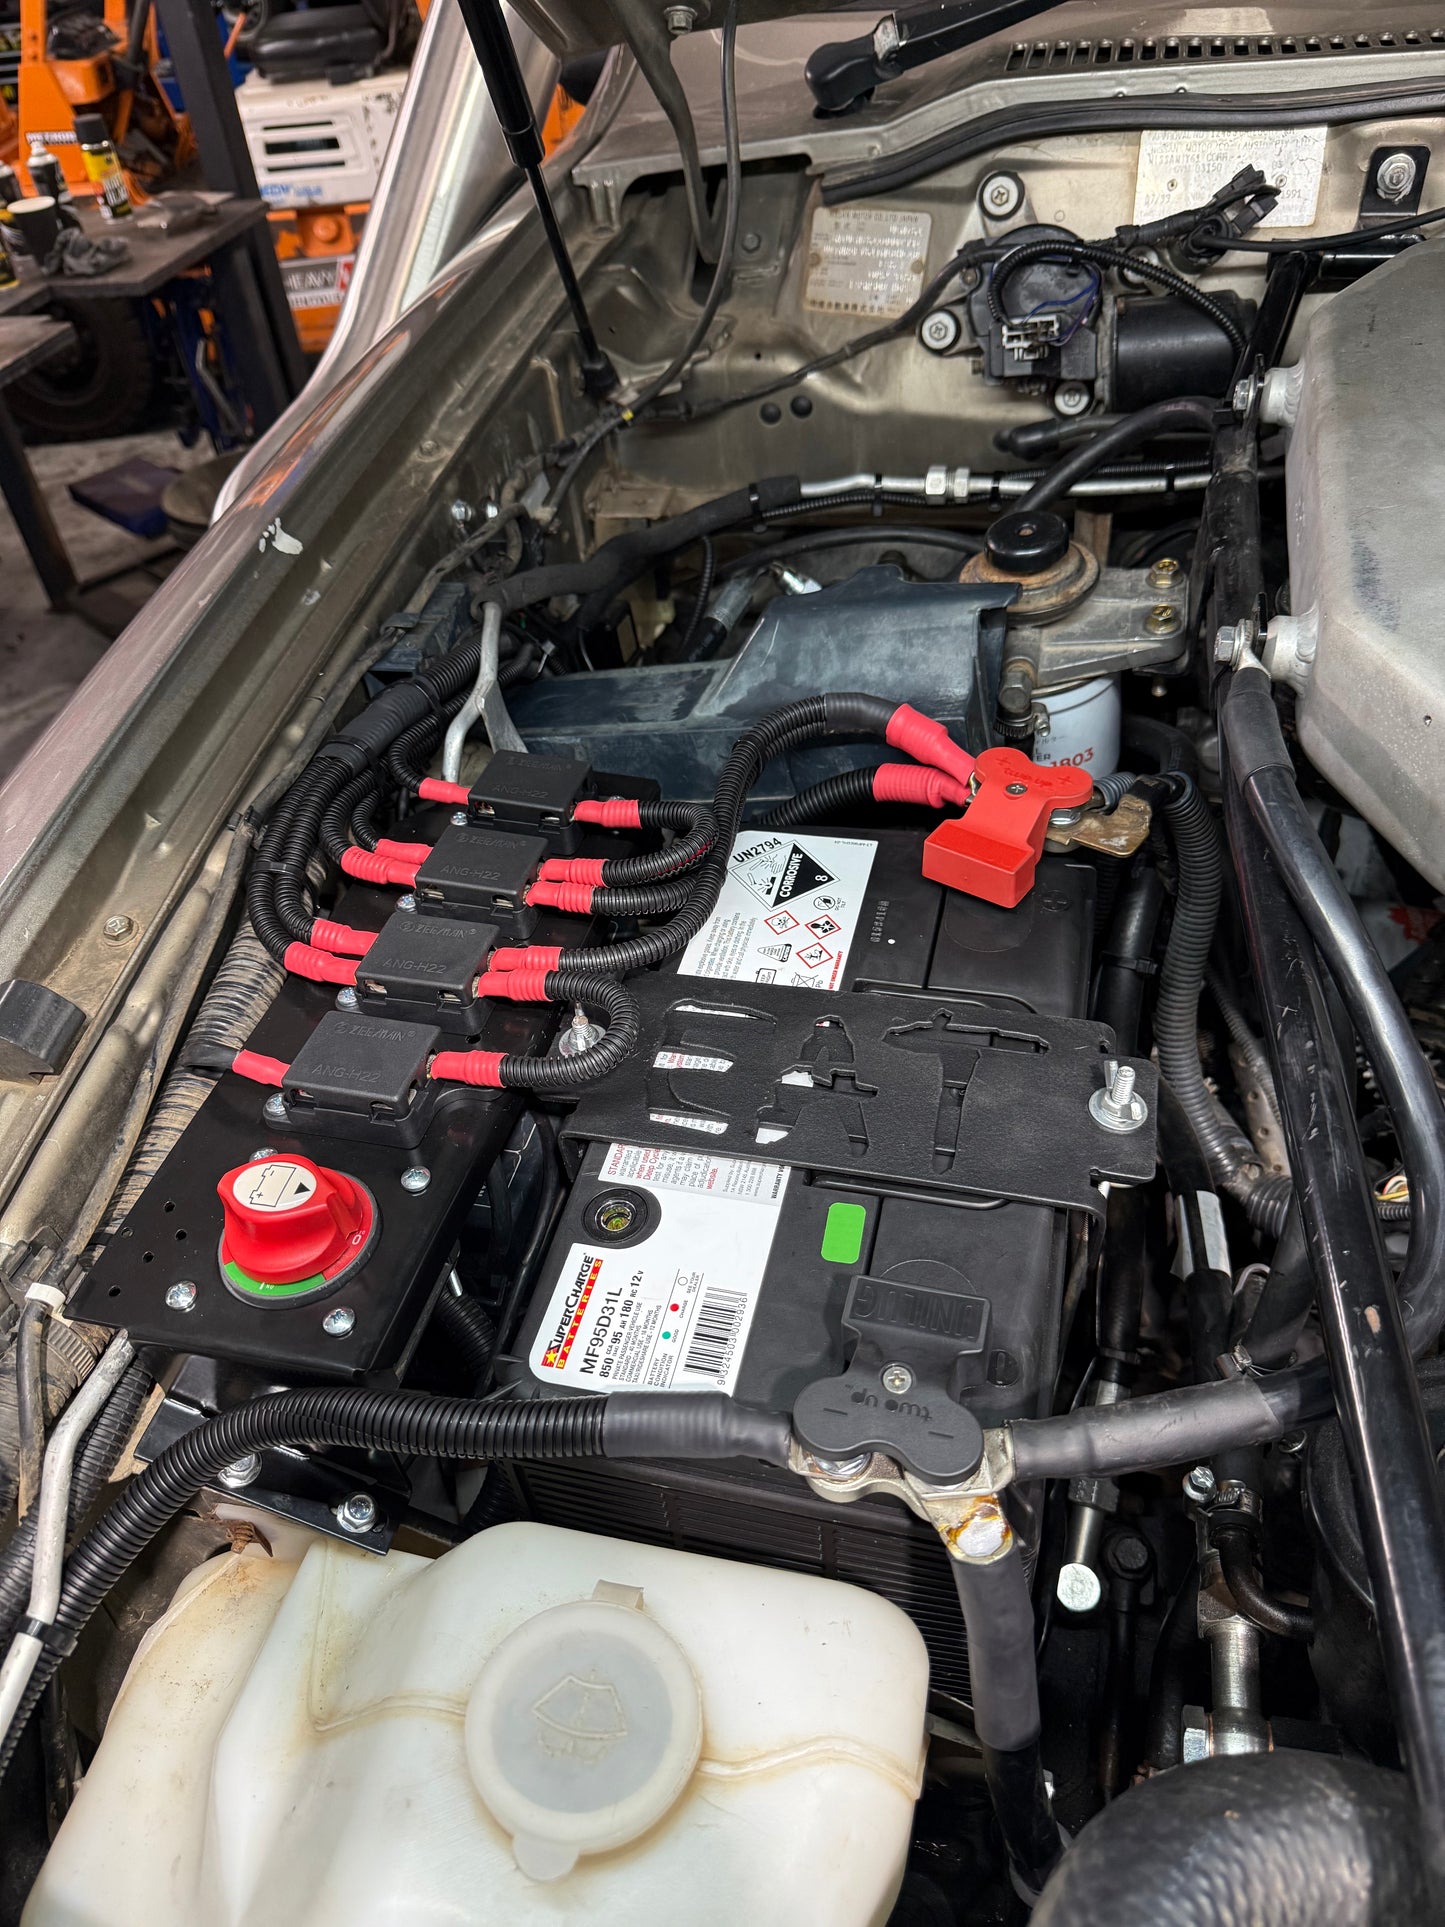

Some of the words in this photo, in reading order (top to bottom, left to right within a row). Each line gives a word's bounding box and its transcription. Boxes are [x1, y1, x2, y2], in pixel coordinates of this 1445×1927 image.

[732, 838, 783, 864] UN2794
[440, 866, 502, 881] ANG-H22
[779, 852, 804, 898] CORROSIVE
[815, 873, 829, 882] 8
[382, 959, 449, 975] ANG-H22
[833, 950, 843, 969] WARRANTY
[311, 1063, 383, 1084] ANG-H22
[606, 1144, 626, 1175] STANDAR
[639, 1149, 651, 1163] used
[634, 1164, 645, 1178] when
[642, 1164, 656, 1180] Deep
[670, 1165, 683, 1184] agents
[704, 1166, 718, 1189] website.
[770, 1173, 782, 1199] WARRANTY
[629, 1275, 642, 1287] 12
[691, 1274, 700, 1292] DEALER
[629, 1288, 638, 1297] RC
[556, 1259, 602, 1368] BATTERIES
[618, 1299, 634, 1318] 180
[678, 1299, 688, 1318] CHARGE
[578, 1285, 623, 1374] MF95D31L
[618, 1319, 627, 1328] AH
[644, 1334, 652, 1344] USE
[650, 1304, 661, 1324] MONTHS
[609, 1330, 623, 1344] 95
[611, 1360, 623, 1379] PRIVATE
[618, 1331, 632, 1359] PASSENGER
[627, 1311, 639, 1331] VEHICLE
[634, 1301, 642, 1311] USE
[624, 1350, 640, 1382] COMMERCIAL
[635, 1339, 643, 1349] USE
[642, 1309, 653, 1329] MONTHS
[719, 1336, 737, 1375] 324503
[730, 1296, 747, 1333] 002936
[605, 1344, 613, 1354] CCA
[618, 1355, 631, 1380] STANDARD
[630, 1324, 641, 1345] MONTHS
[598, 1357, 615, 1377] 850
[647, 1357, 660, 1385] BATTERY
[652, 1352, 668, 1386] CONDITION
[659, 1354, 674, 1387] INDICATOR
